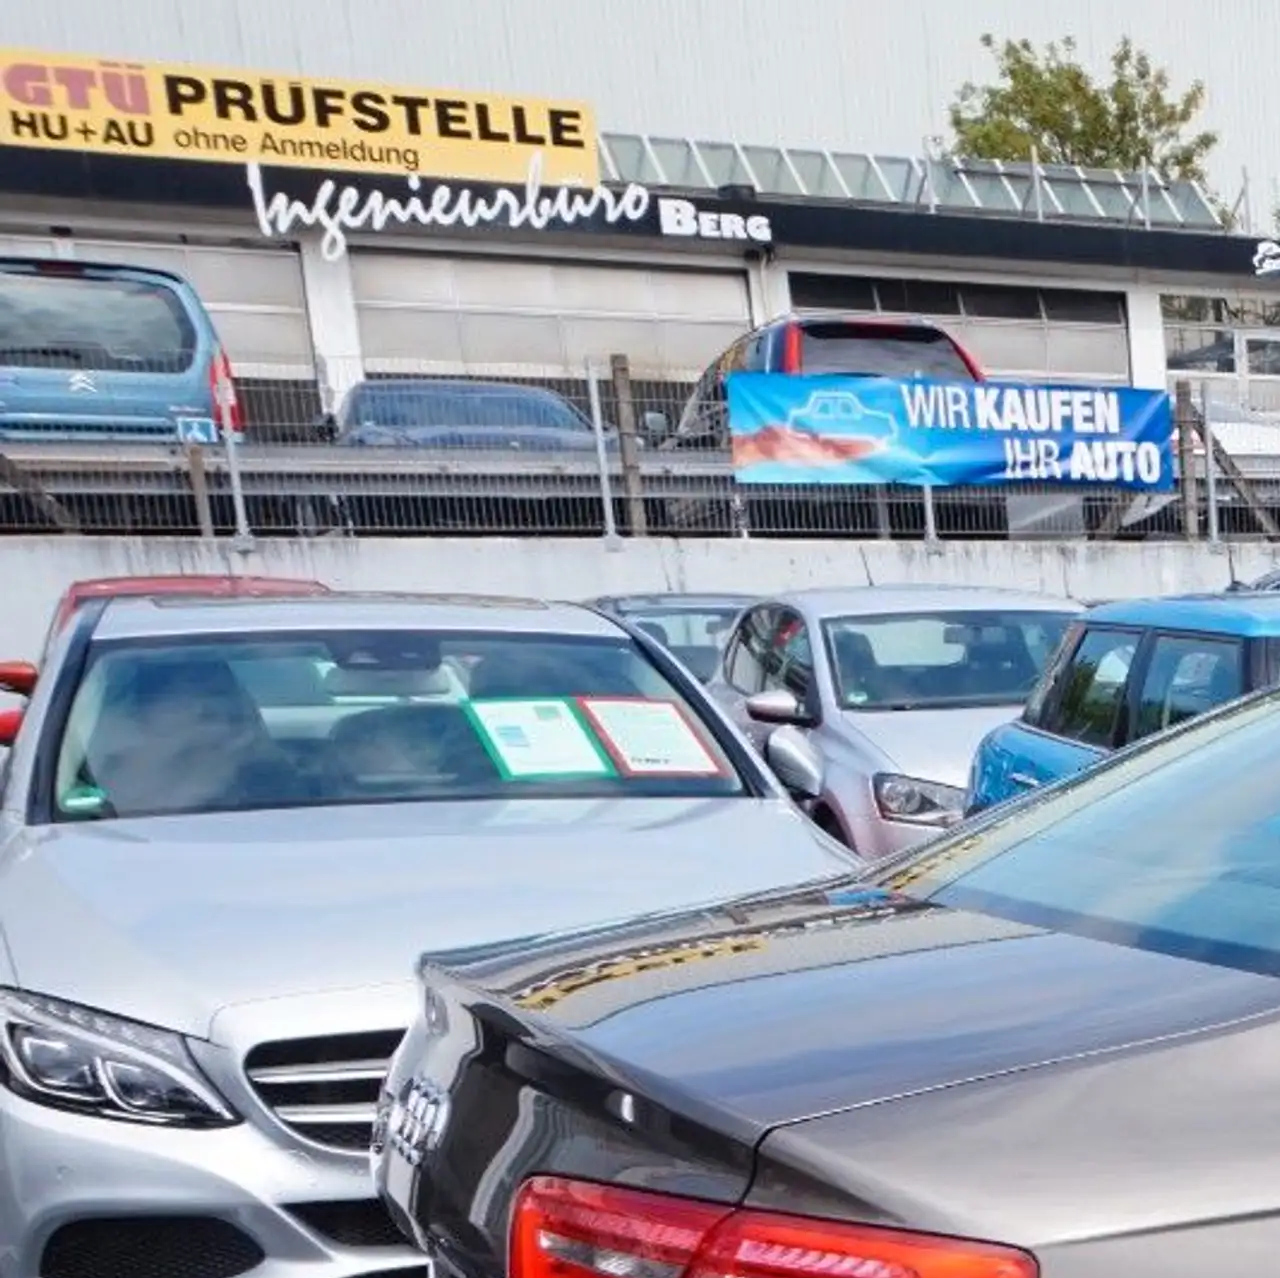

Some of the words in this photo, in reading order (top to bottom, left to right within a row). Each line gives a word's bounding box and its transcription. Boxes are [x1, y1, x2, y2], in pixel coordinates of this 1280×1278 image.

[4, 61, 150, 116] GTÜ
[163, 74, 586, 149] PRÜFSTELLE
[174, 126, 249, 153] ohne
[260, 131, 421, 172] Anmeldung
[900, 383, 970, 429] WIR
[974, 387, 1120, 433] KAUFEN
[1004, 438, 1062, 480] IHR
[1070, 441, 1160, 484] AUTO
